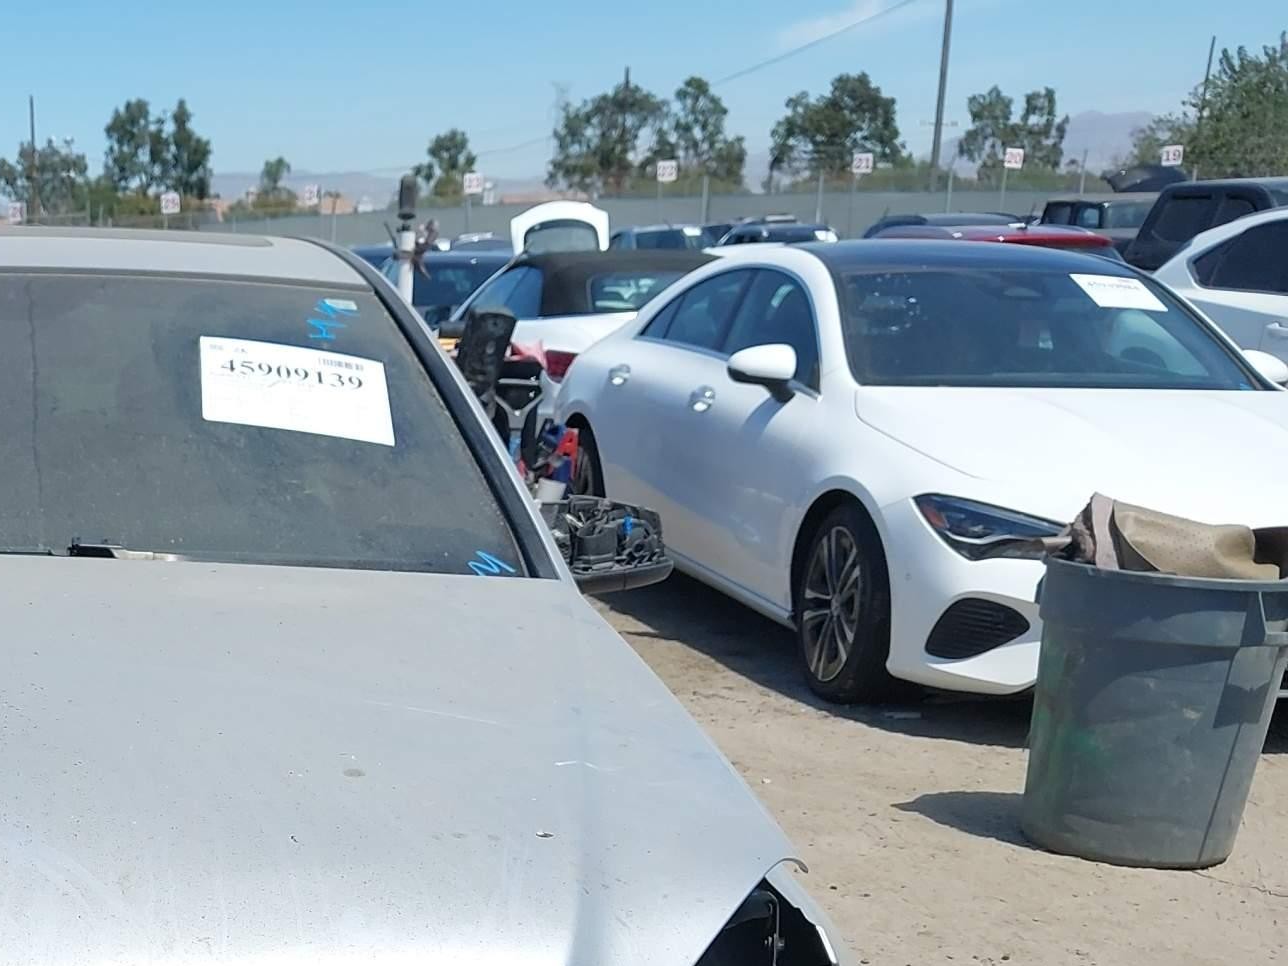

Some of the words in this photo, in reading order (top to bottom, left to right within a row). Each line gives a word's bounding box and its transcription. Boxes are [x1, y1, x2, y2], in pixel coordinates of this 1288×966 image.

[1164, 148, 1181, 162] 19
[853, 156, 871, 169] 21
[220, 359, 363, 389] 45909139
